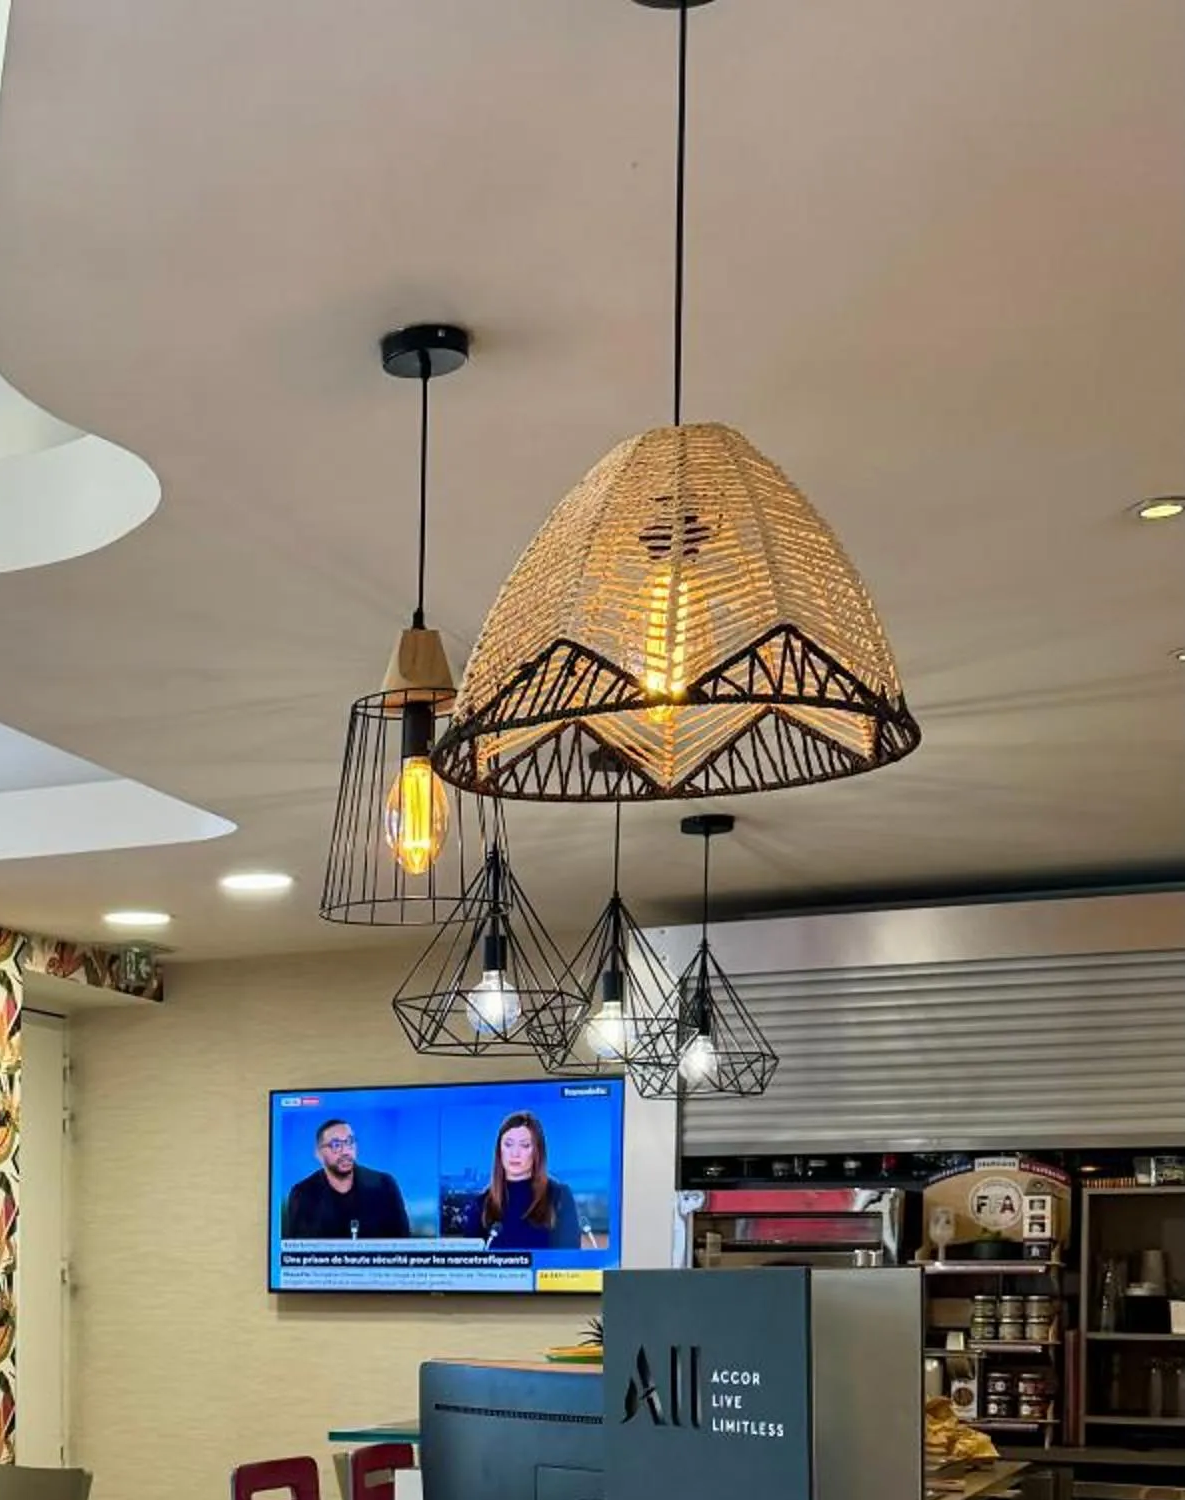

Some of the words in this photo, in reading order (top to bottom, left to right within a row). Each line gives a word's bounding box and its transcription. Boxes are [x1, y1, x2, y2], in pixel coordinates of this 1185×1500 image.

[302, 1255, 329, 1266] prison
[331, 1255, 342, 1264] de
[409, 1257, 431, 1267] pour
[433, 1256, 445, 1264] les
[711, 1370, 760, 1385] ACCOR
[712, 1394, 742, 1409] LIVE
[712, 1418, 784, 1437] LIMITLESS
